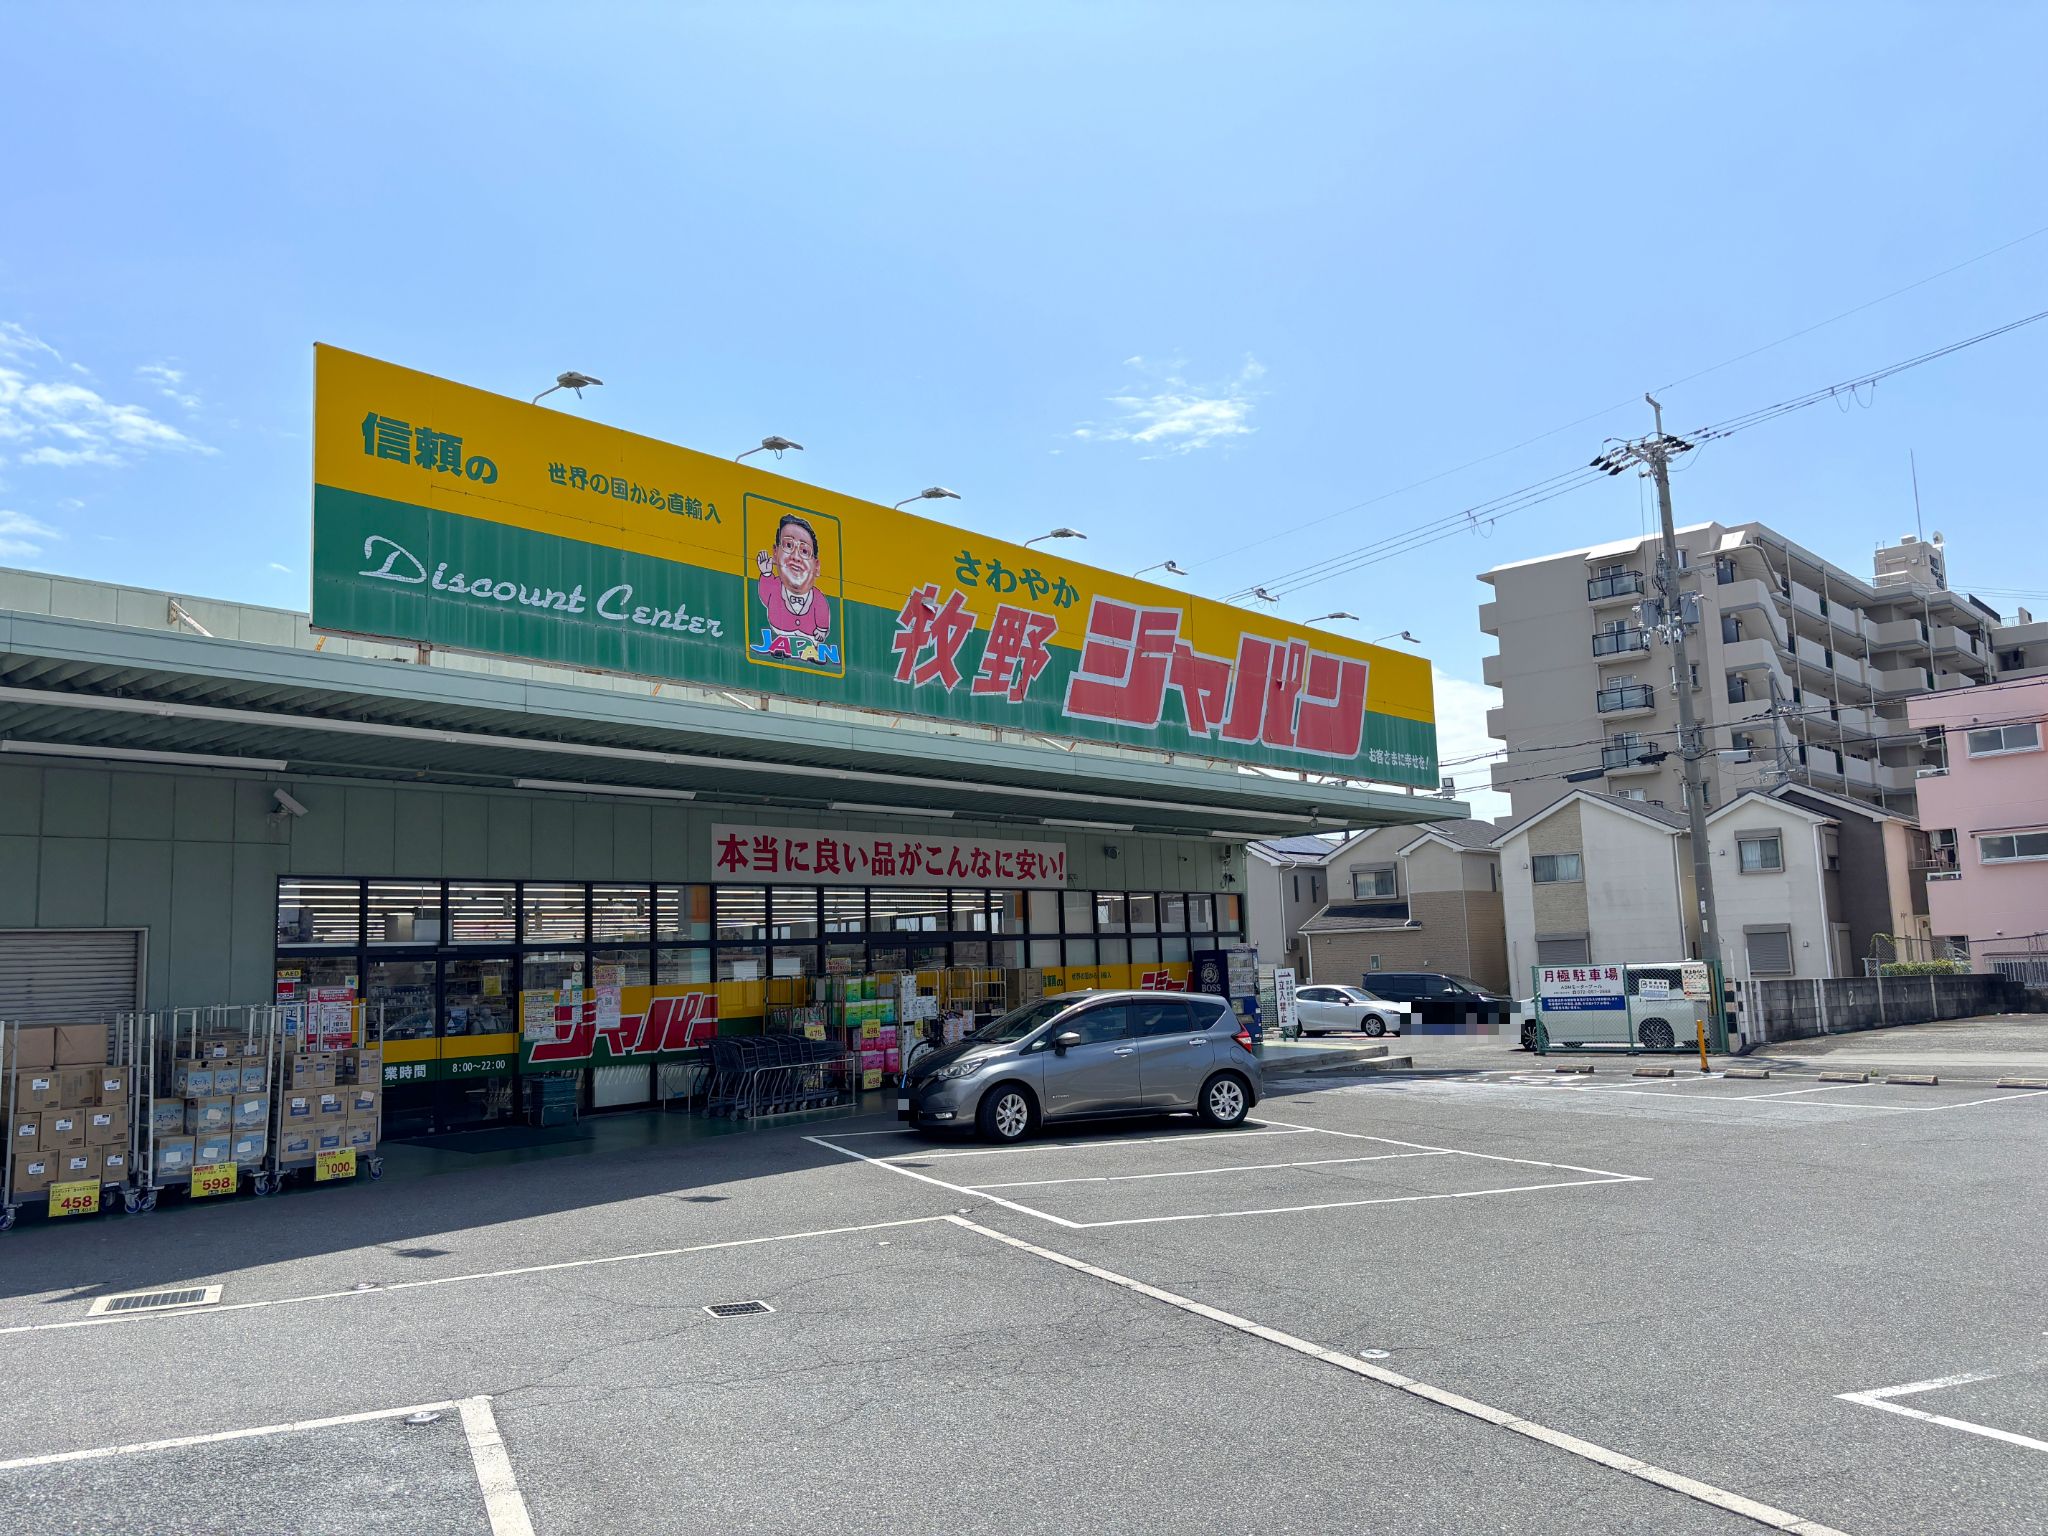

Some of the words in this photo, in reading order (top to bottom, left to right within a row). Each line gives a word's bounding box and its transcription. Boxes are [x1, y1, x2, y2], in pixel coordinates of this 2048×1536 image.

[361, 411, 498, 484] 信頼の
[548, 462, 722, 525] 世界の国から直輸入
[358, 534, 587, 614] Discount
[596, 584, 724, 638] Center
[954, 549, 1081, 609] さわやか
[750, 628, 842, 665] JAPAN
[717, 833, 1065, 881] 本当に良い品がこんなに安い!
[1201, 983, 1222, 993] BOSS
[1544, 967, 1619, 983] 月極駐車場
[1903, 986, 1909, 1004] 3
[1848, 990, 1856, 1007] 2
